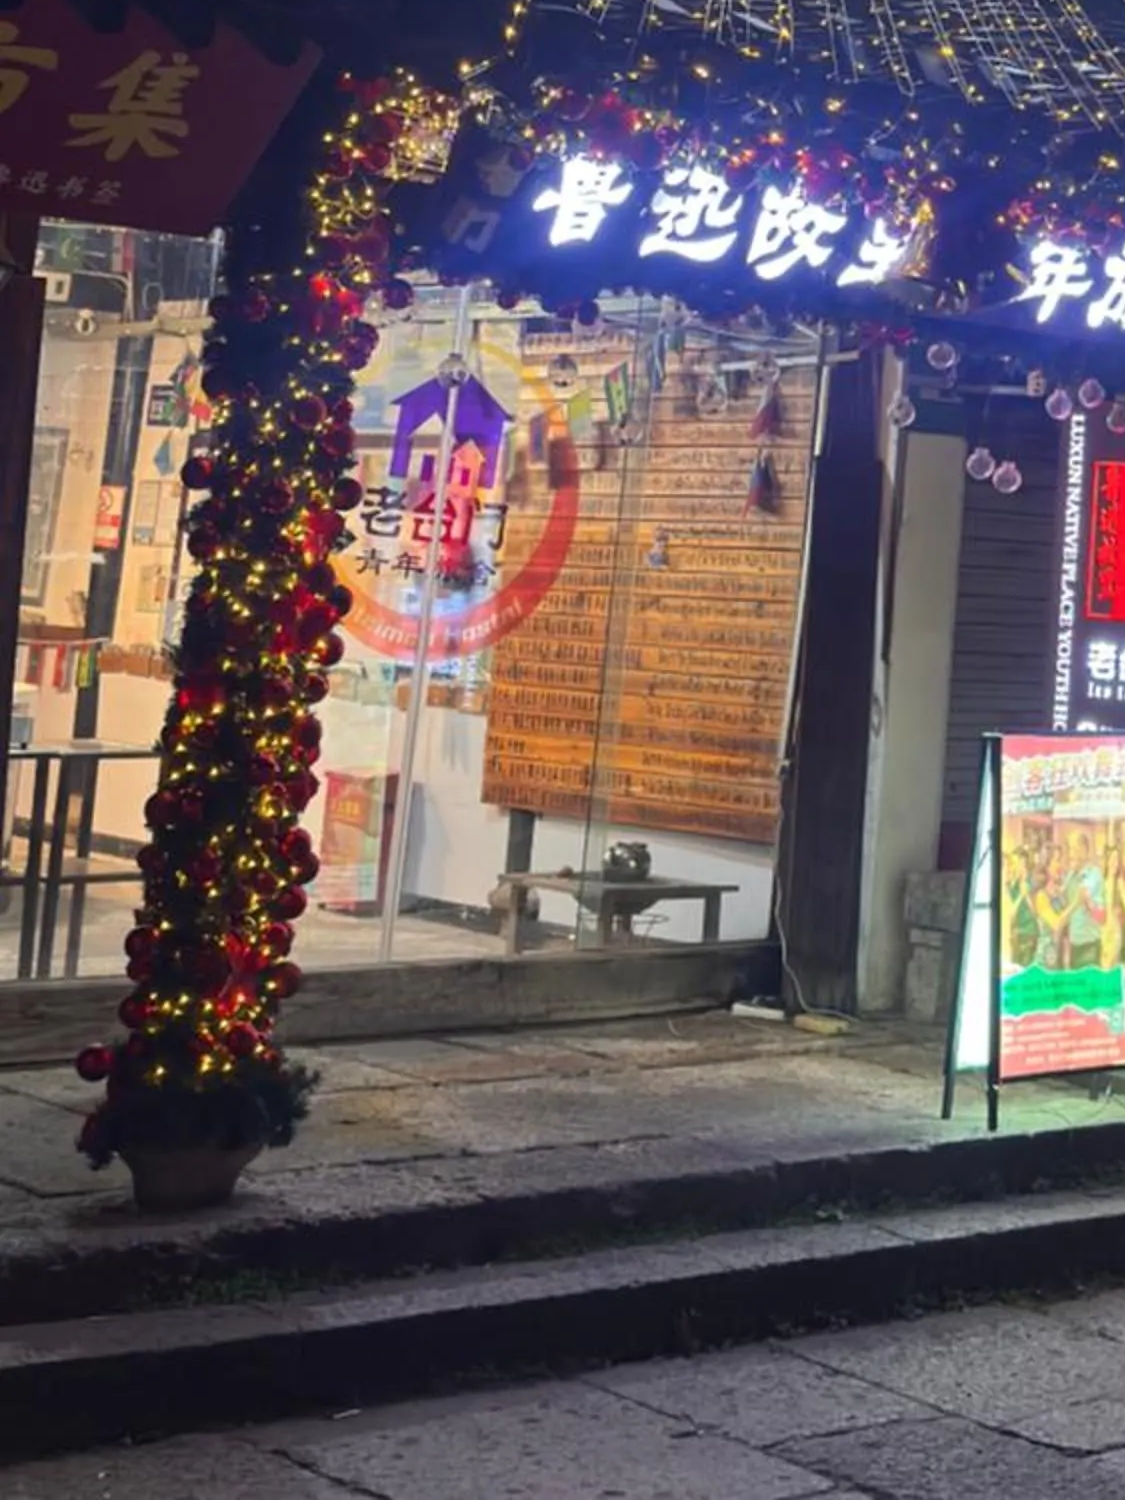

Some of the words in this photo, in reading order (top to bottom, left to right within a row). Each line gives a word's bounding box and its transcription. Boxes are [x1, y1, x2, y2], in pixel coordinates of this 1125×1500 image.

[1068, 413, 1086, 484] LUXUN
[1063, 486, 1081, 559] NATIVE
[1059, 562, 1077, 628] PLACE
[1054, 630, 1072, 702] YOUTH
